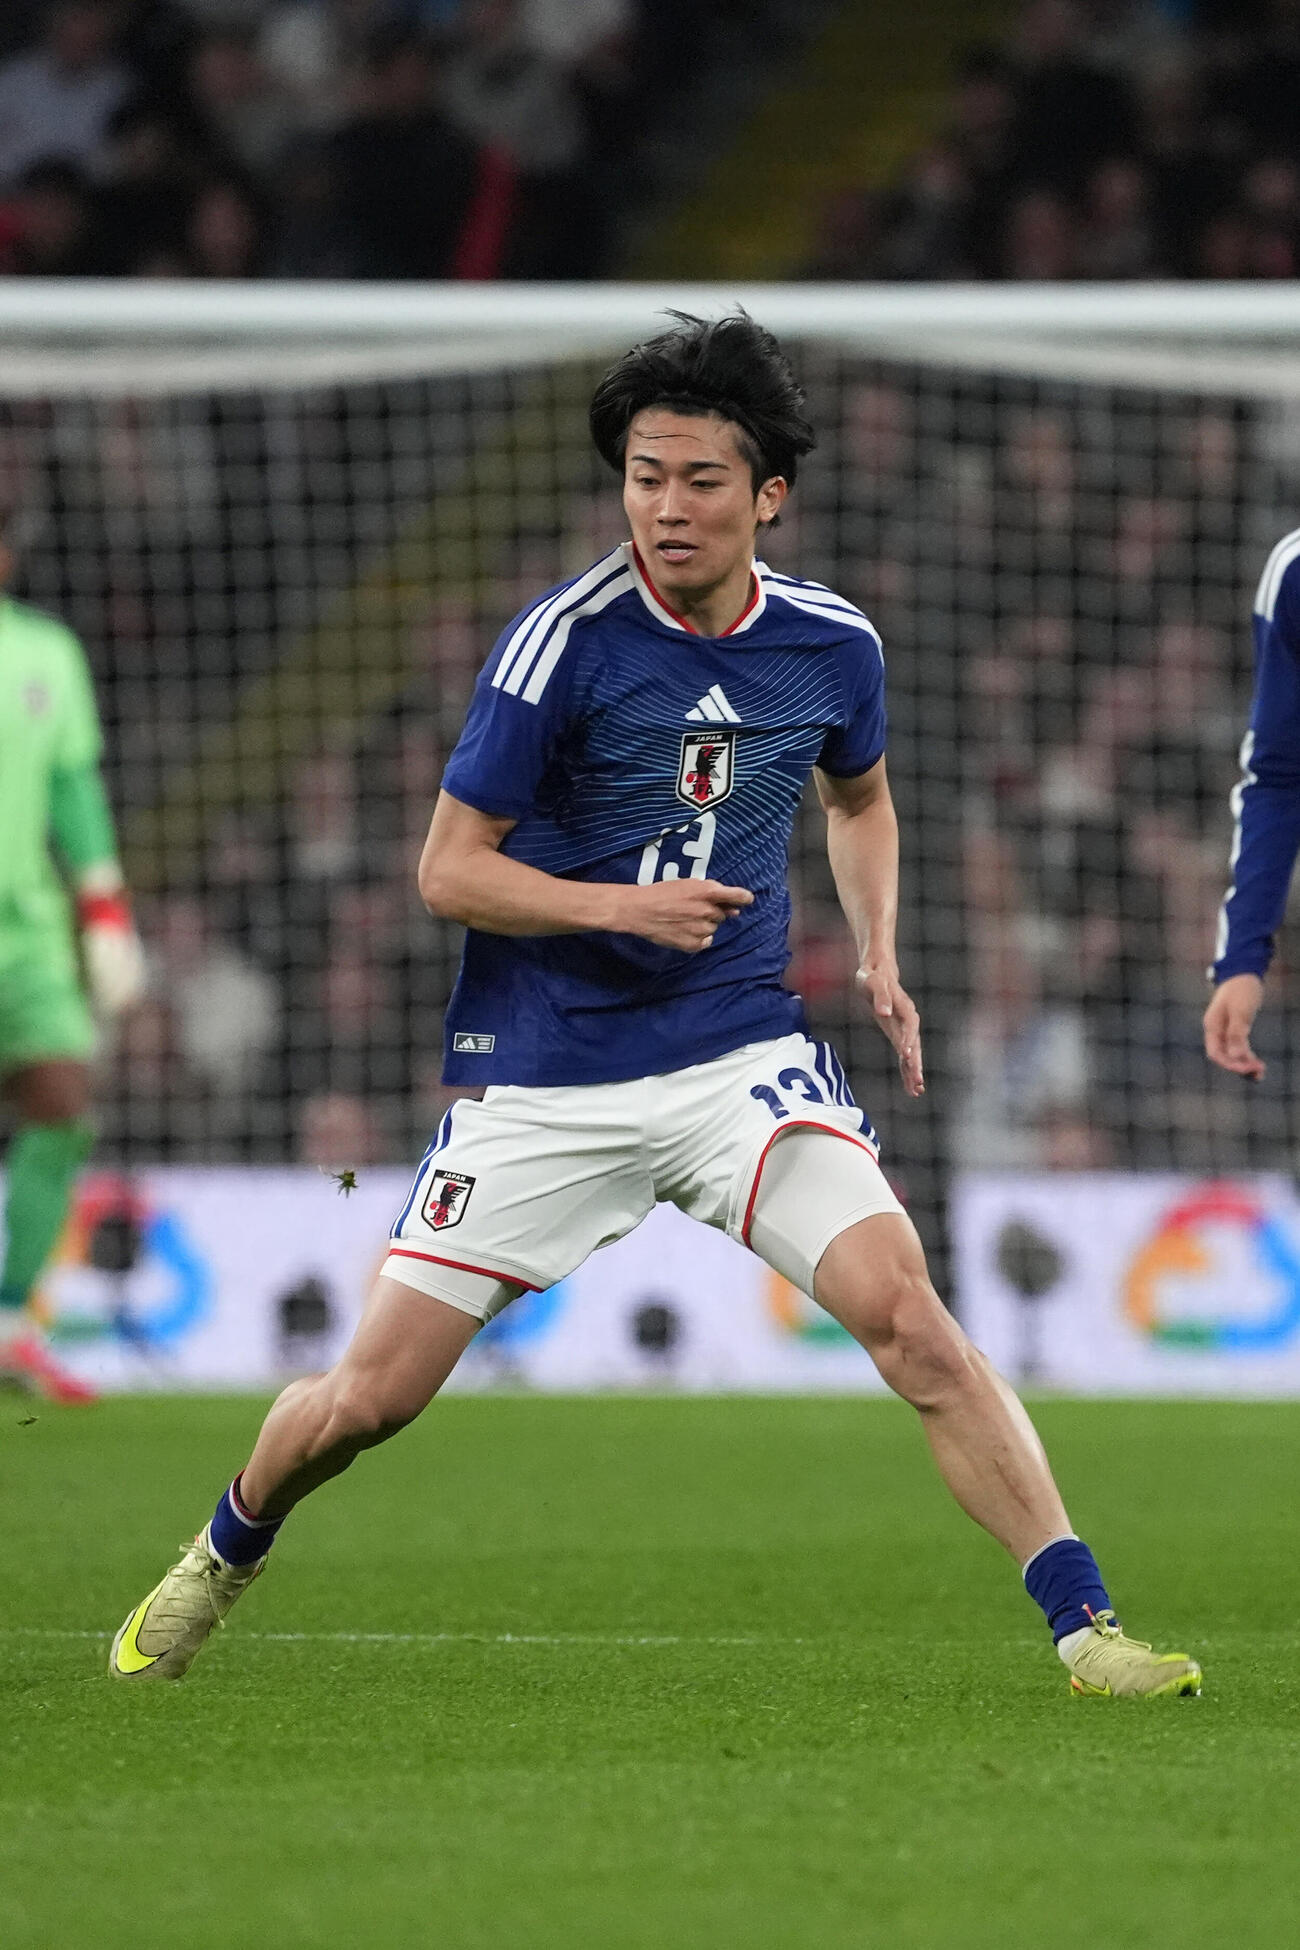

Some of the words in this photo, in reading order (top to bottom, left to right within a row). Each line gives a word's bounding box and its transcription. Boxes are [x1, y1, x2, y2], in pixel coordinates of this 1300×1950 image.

[694, 734, 723, 743] JAPAN
[689, 784, 715, 796] JFA
[637, 811, 717, 886] 13
[443, 1172, 467, 1182] JAPAN
[430, 1212, 449, 1223] JFA
